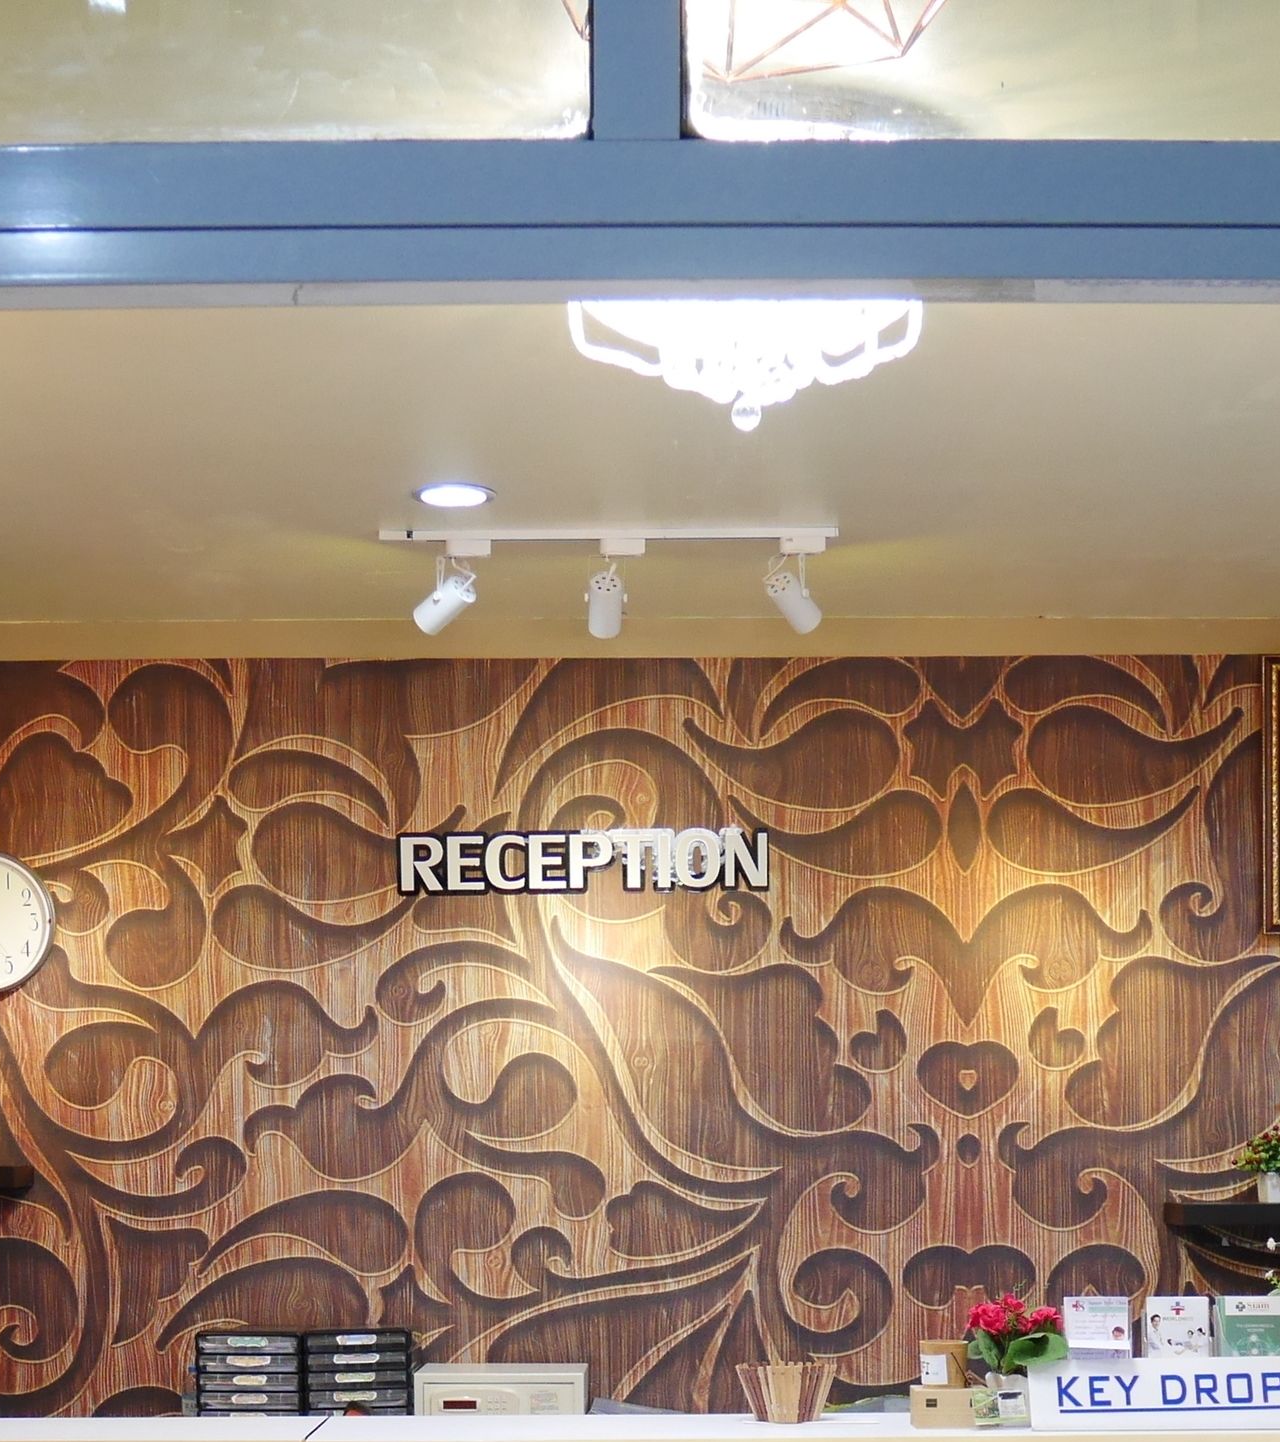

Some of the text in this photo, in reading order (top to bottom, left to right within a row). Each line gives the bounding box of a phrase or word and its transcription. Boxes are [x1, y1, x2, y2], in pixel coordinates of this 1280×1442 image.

[398, 830, 769, 894] RECEPTION
[21, 887, 32, 907] 2
[30, 912, 39, 932] 3
[20, 939, 31, 957] 4
[5, 955, 14, 975] 5
[1056, 1375, 1140, 1407] KEY
